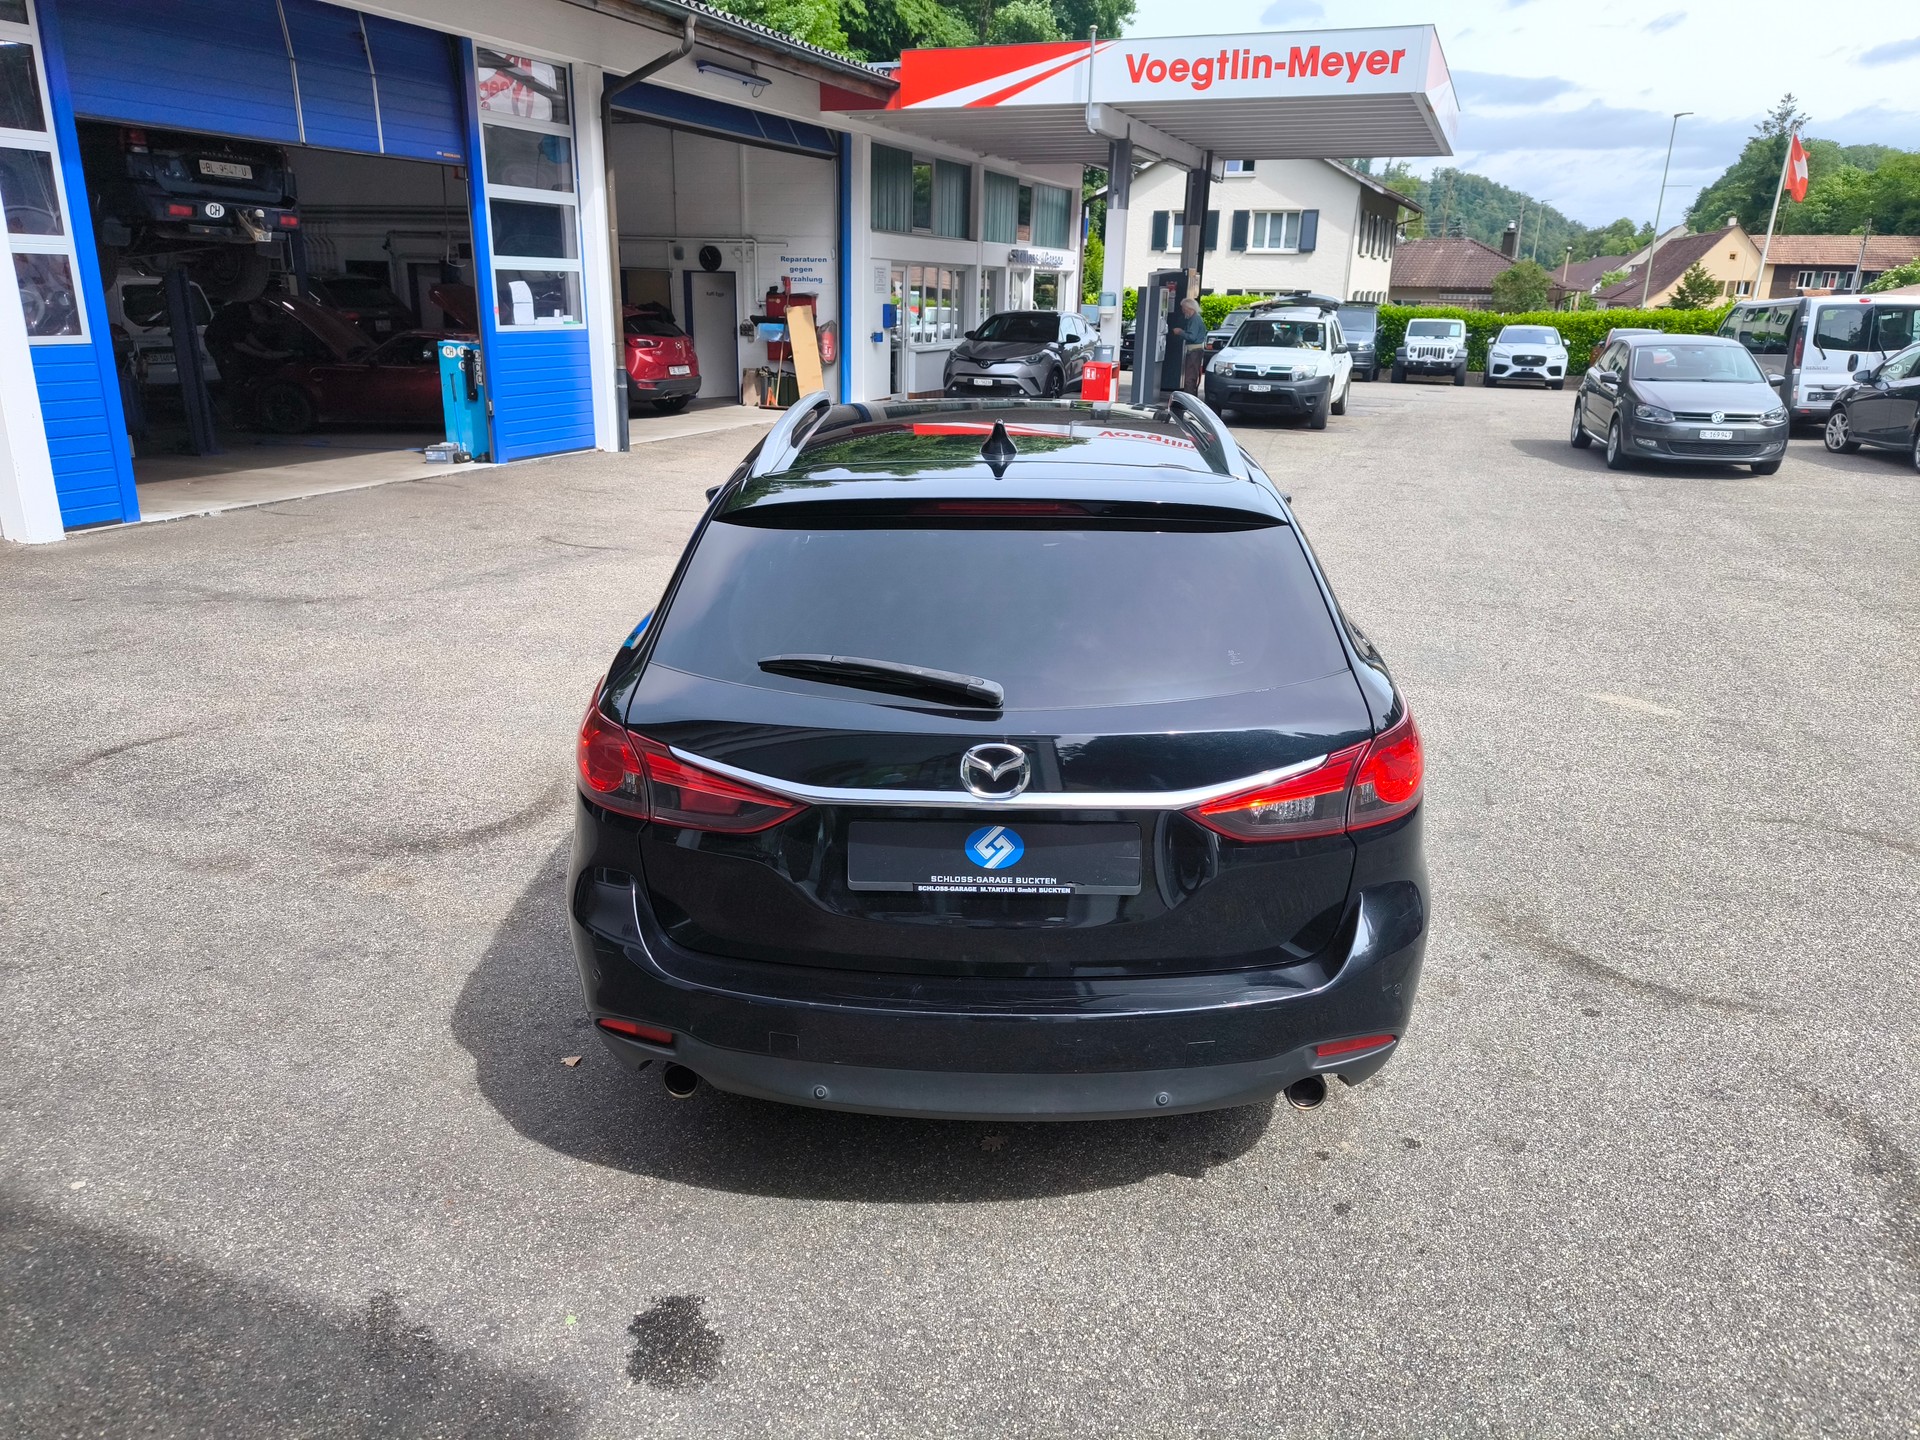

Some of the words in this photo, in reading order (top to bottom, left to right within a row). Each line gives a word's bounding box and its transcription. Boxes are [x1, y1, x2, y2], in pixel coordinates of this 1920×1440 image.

[1126, 45, 1406, 90] Voegtlin-Meyer
[209, 204, 221, 216] CH
[445, 346, 454, 356] CH
[930, 875, 1013, 884] SCHLOSS-GARAGE
[1015, 877, 1057, 885] BUCKTEN
